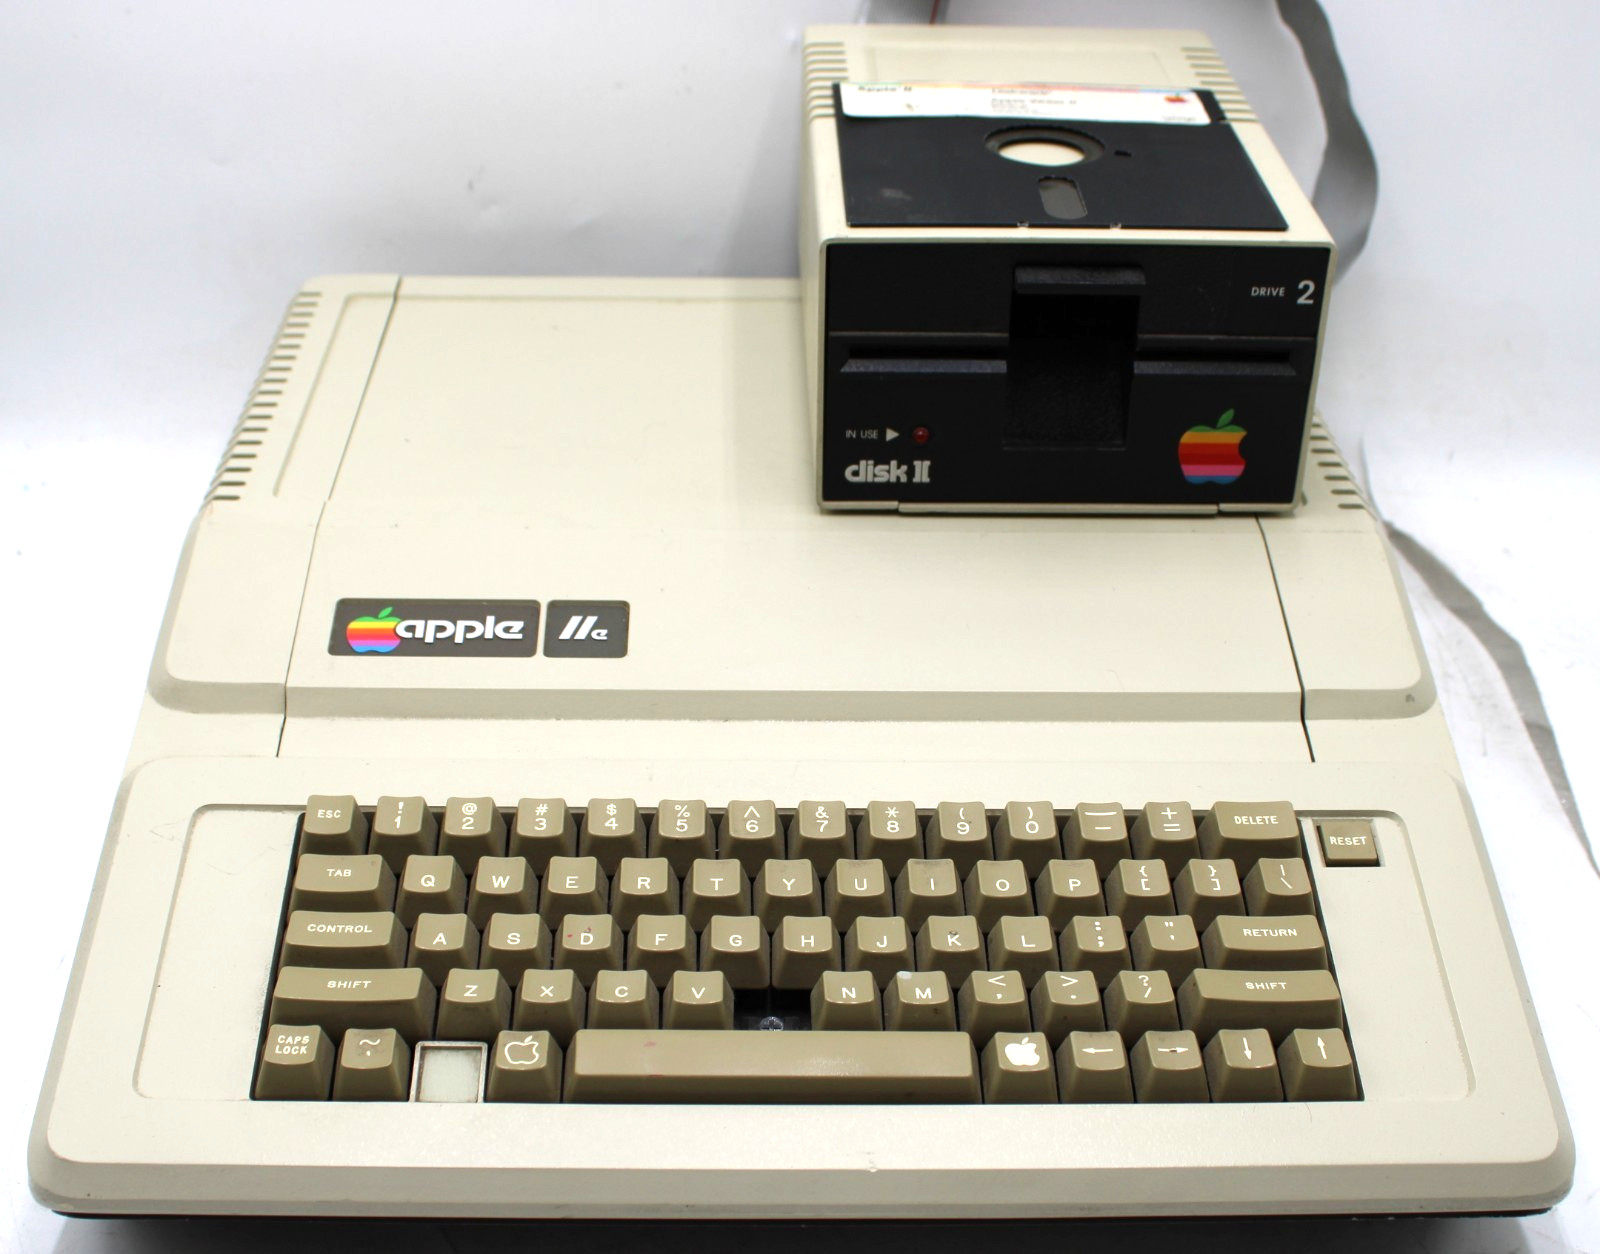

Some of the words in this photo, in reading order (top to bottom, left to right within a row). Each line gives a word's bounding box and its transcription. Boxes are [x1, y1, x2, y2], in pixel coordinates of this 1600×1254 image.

[1251, 287, 1284, 296] DRIVE
[1297, 280, 1315, 304] 2
[846, 430, 856, 438] IN
[861, 430, 877, 439] USE
[845, 460, 907, 482] disk
[395, 616, 524, 644] apple
[318, 810, 340, 818] ESC
[462, 803, 477, 815] @
[536, 804, 548, 815] #
[607, 804, 616, 816] $
[675, 805, 690, 817] %
[816, 806, 829, 818] &
[1161, 808, 1177, 819] +
[462, 817, 474, 829] 2
[535, 818, 546, 830] 3
[605, 818, 618, 829] 4
[676, 819, 688, 832] 5
[1235, 816, 1278, 824] DELETE
[746, 820, 758, 832] 6
[817, 820, 828, 832] 7
[887, 821, 899, 832] 8
[957, 822, 969, 834] 9
[1026, 821, 1039, 833] 0
[1330, 836, 1366, 845] RESET
[1140, 866, 1147, 877] {
[1208, 865, 1216, 876] }
[421, 875, 435, 887] Q
[492, 876, 509, 888] W
[566, 876, 578, 888] E
[638, 877, 650, 889] R
[710, 878, 723, 890] T
[783, 879, 795, 890] Y
[855, 879, 867, 890] U
[996, 880, 1009, 891] O
[1069, 879, 1081, 891] P
[1141, 879, 1150, 890] [
[1210, 878, 1221, 891] ]
[1281, 878, 1292, 888] \
[308, 924, 372, 932] CONTROL
[433, 933, 446, 944] A
[507, 933, 520, 944] S
[581, 933, 593, 945] D
[656, 934, 668, 945] F
[729, 935, 742, 946] G
[801, 936, 814, 947] H
[877, 936, 887, 947] J
[948, 935, 961, 946] K
[1022, 936, 1035, 947] L
[988, 976, 1006, 986] <
[1061, 976, 1078, 986] >
[1139, 975, 1149, 986] ?
[464, 985, 477, 996] Z
[540, 986, 553, 997] X
[615, 986, 628, 997] C
[692, 988, 705, 998] V
[842, 988, 856, 998] N
[916, 988, 931, 998] M
[1144, 985, 1153, 999] /
[278, 1035, 309, 1044] CAPS
[275, 1045, 307, 1054] LOCK
